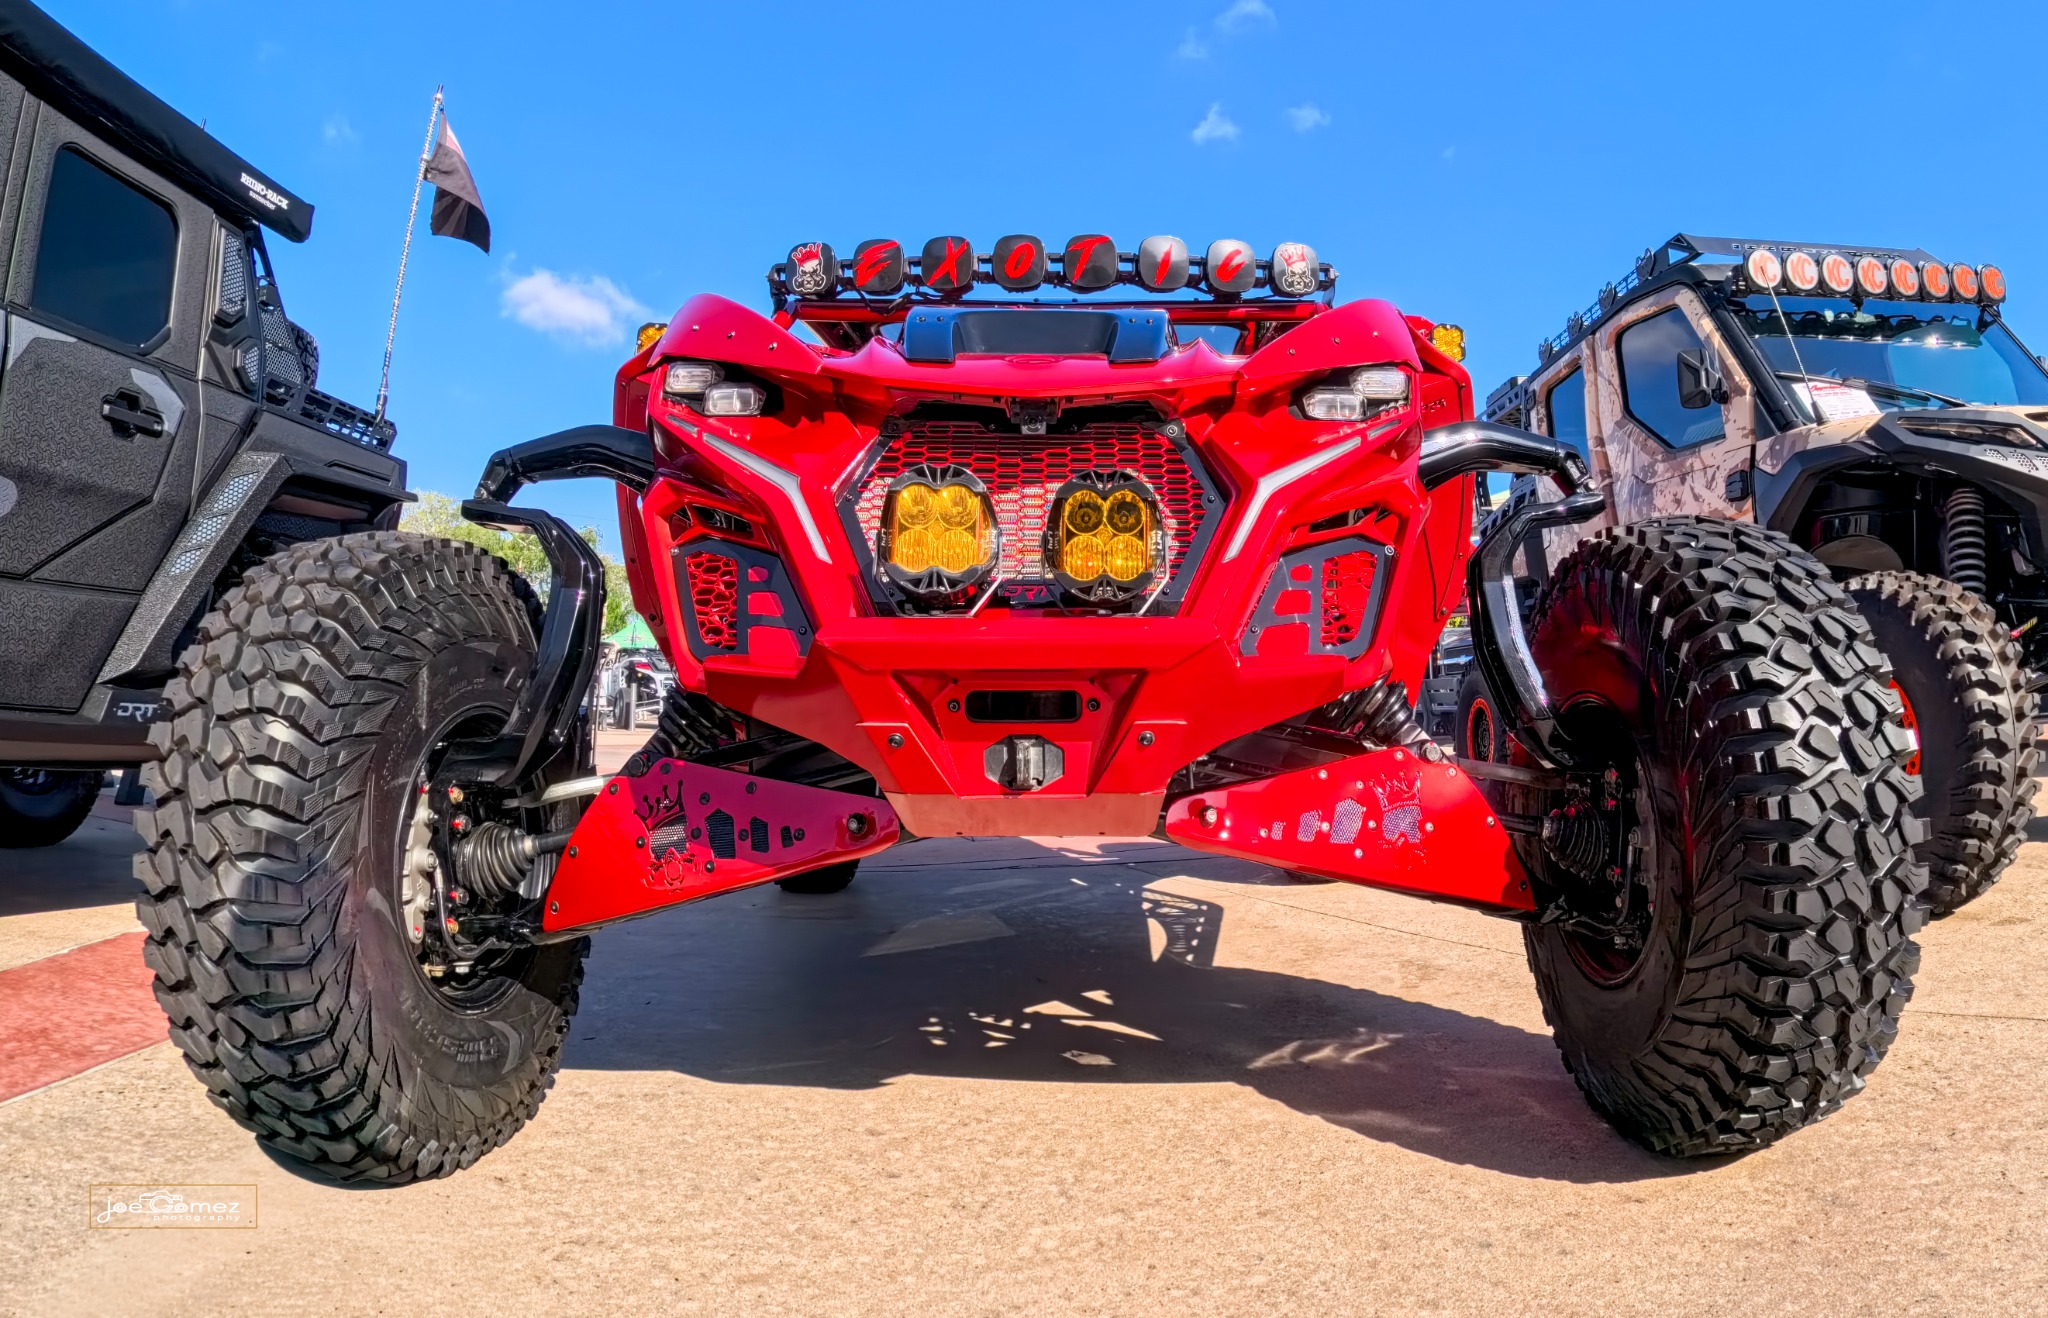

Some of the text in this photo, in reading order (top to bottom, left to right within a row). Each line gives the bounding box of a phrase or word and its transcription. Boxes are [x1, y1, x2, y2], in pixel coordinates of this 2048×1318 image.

[240, 172, 289, 210] RHINO-RACK
[1752, 252, 1777, 283] KC
[1790, 254, 1816, 287] KC
[1827, 256, 1851, 289] KC
[1861, 259, 1885, 291] KC
[1894, 262, 1917, 293] KC
[1926, 264, 1947, 295] KC
[1955, 266, 1976, 297] KC
[1984, 267, 2004, 298] KC
[117, 702, 159, 722] DRT
